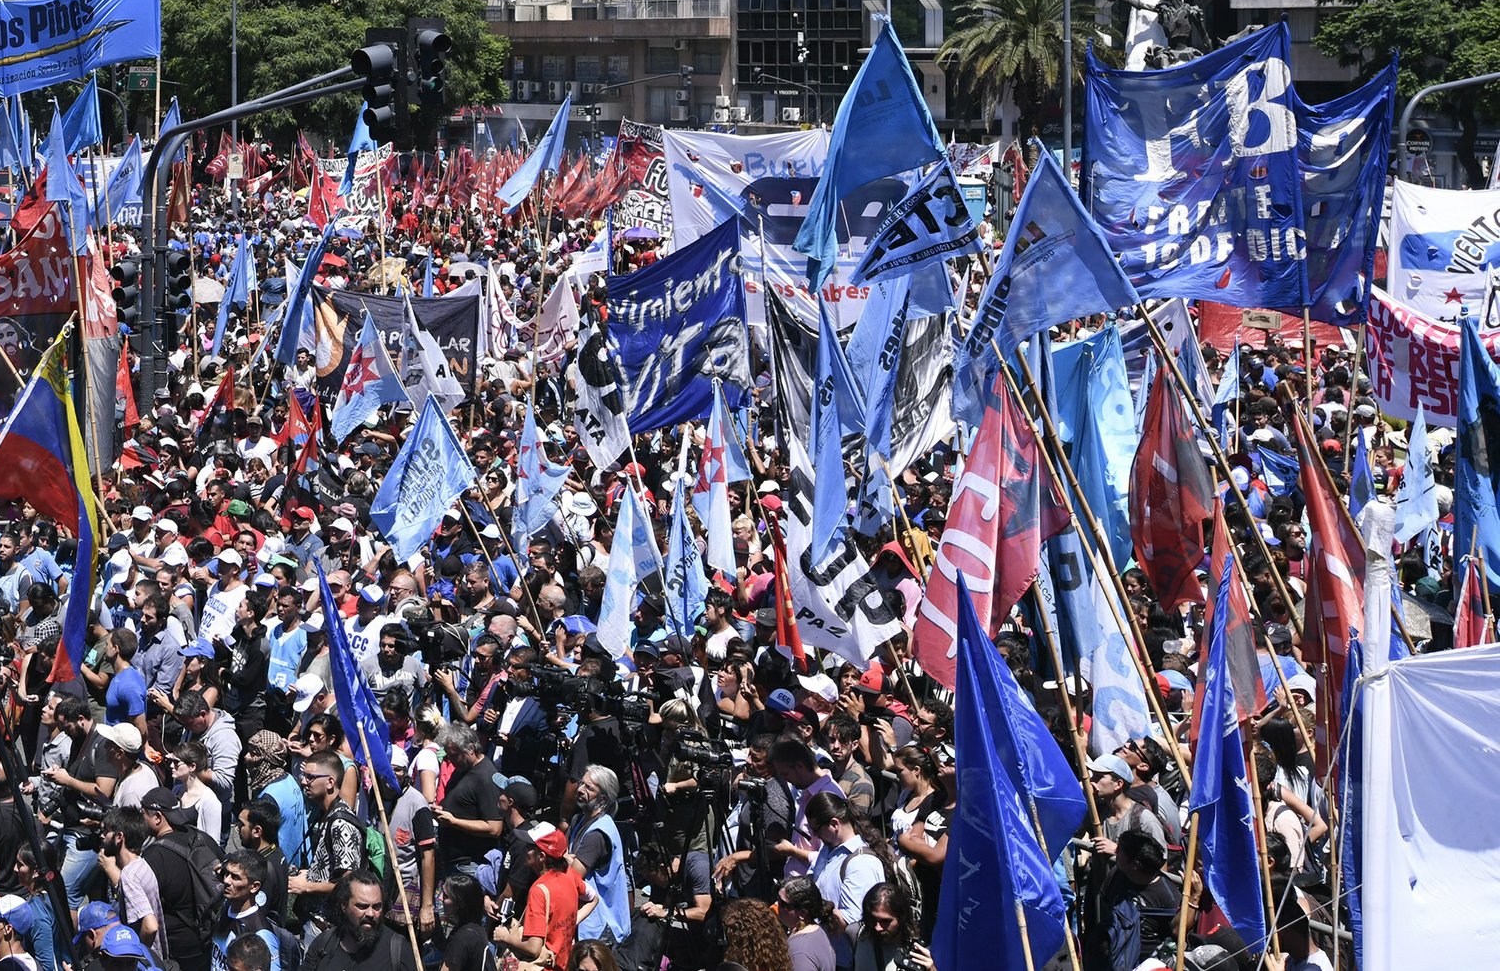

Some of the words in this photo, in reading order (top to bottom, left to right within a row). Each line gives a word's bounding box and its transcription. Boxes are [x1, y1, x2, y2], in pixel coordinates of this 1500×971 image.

[608, 248, 745, 330] vimiento
[608, 317, 752, 418] VITA
[1409, 342, 1459, 384] REC
[575, 408, 606, 447] ATA
[796, 606, 847, 638] PAZ
